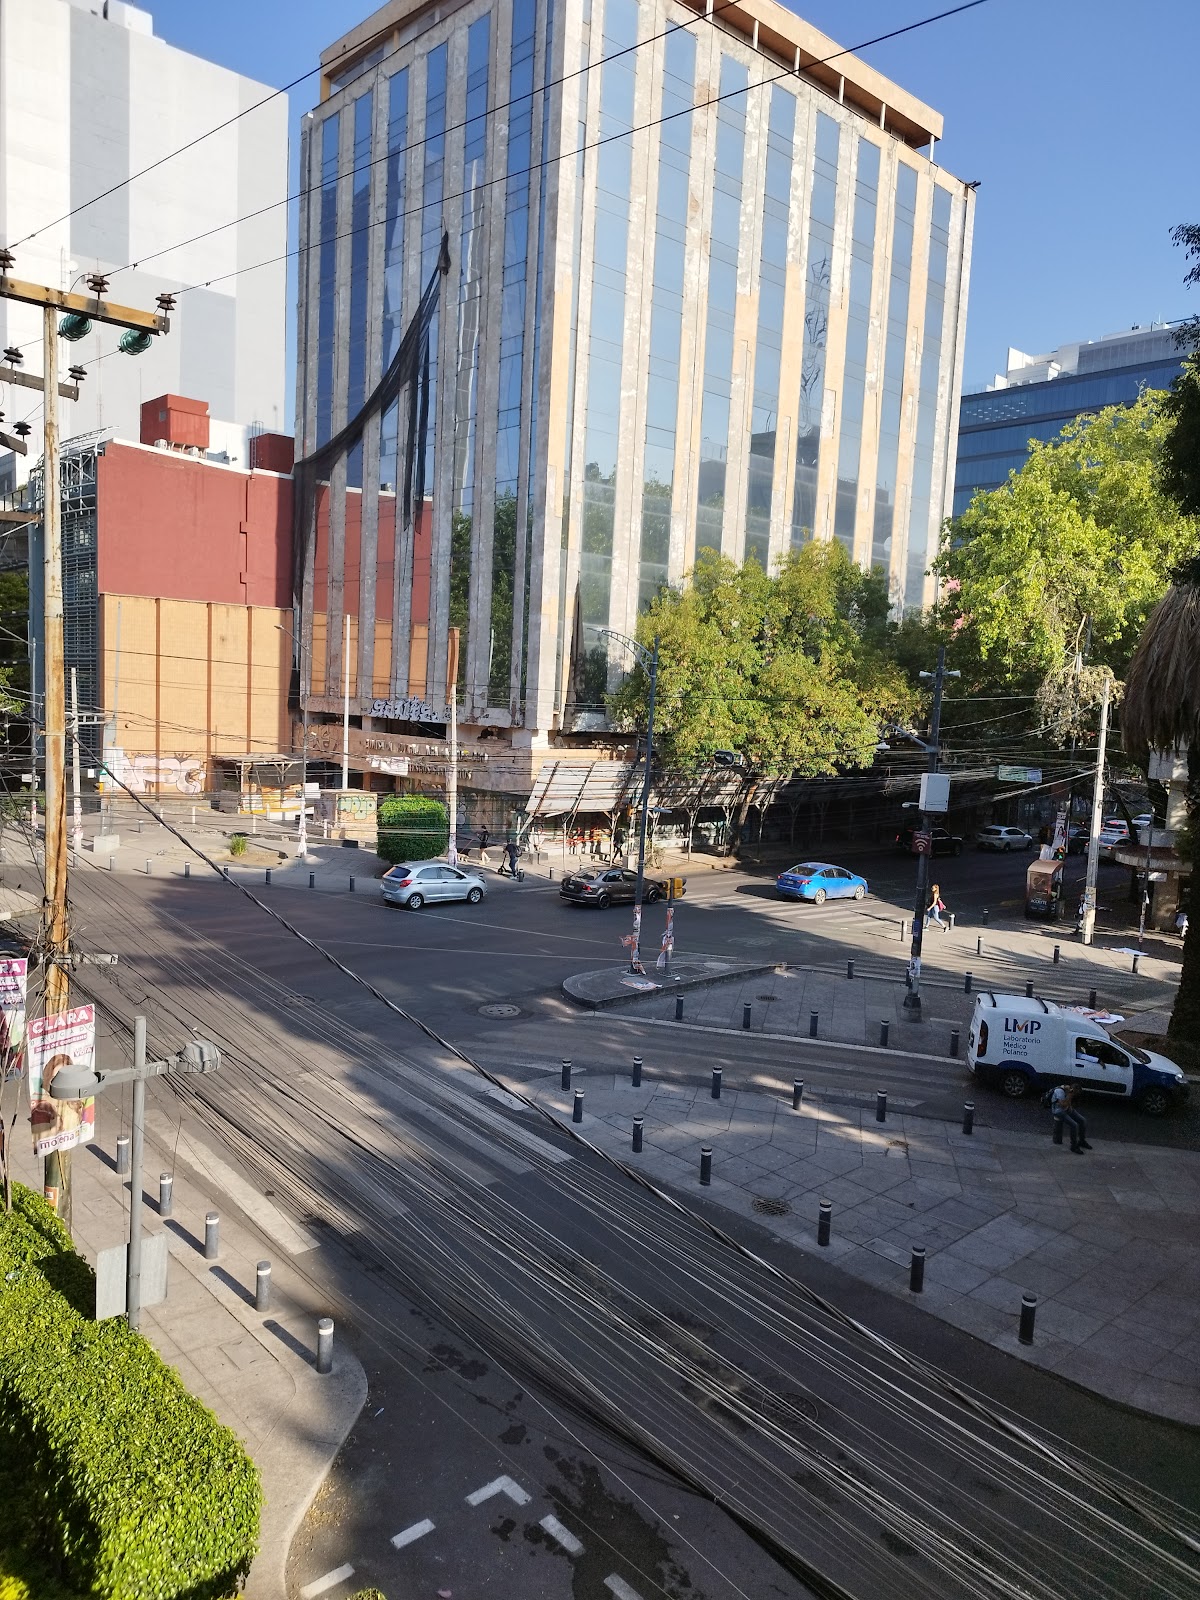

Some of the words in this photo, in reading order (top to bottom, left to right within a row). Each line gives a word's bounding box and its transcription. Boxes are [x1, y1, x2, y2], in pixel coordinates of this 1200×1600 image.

[32, 1009, 89, 1034] CLARA
[1004, 1017, 1041, 1034] LMP
[1003, 1035, 1041, 1043] Laboratorio
[1002, 1048, 1028, 1056] Polanco
[40, 1133, 75, 1150] morena
